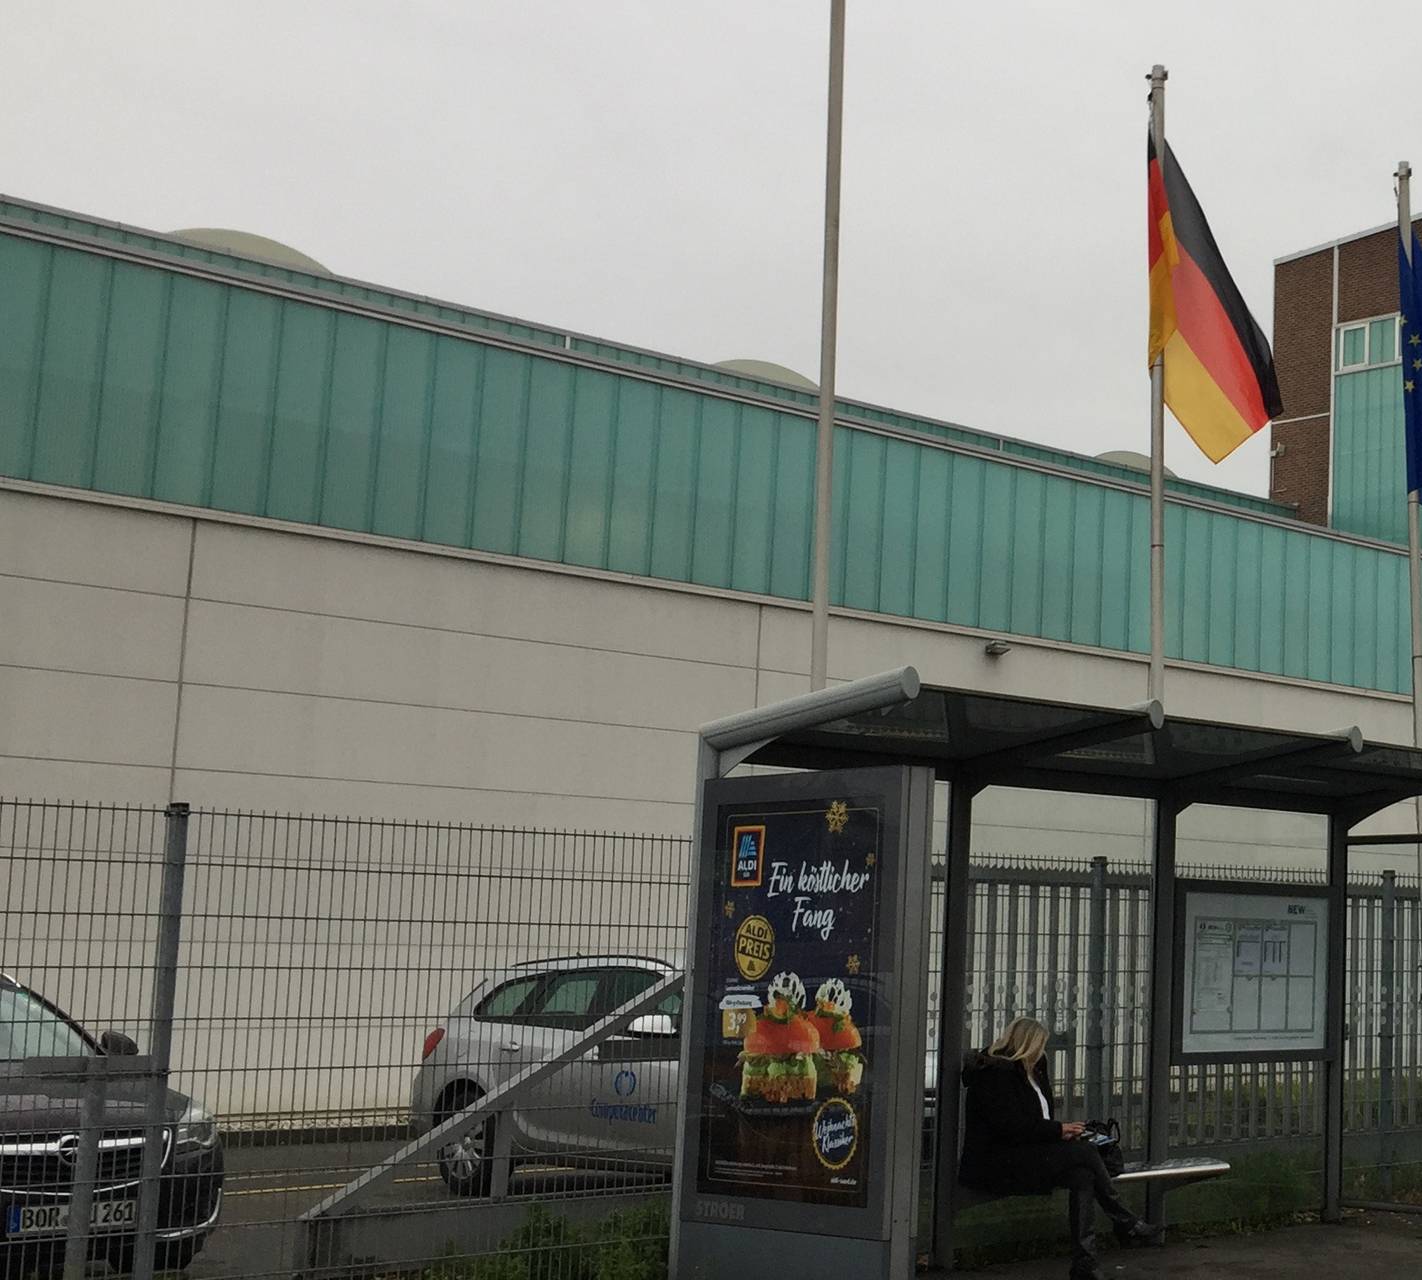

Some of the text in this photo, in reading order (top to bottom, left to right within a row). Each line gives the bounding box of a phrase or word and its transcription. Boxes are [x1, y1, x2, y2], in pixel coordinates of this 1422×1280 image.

[737, 860, 758, 871] ALDI
[767, 858, 870, 898] Ein köstlicher
[745, 923, 768, 939] ALDI
[791, 896, 836, 941] Fang
[738, 936, 771, 961] PREIS
[22, 1207, 60, 1229] BOR
[103, 1201, 134, 1223] 261
[695, 1199, 745, 1220] STRÖER
